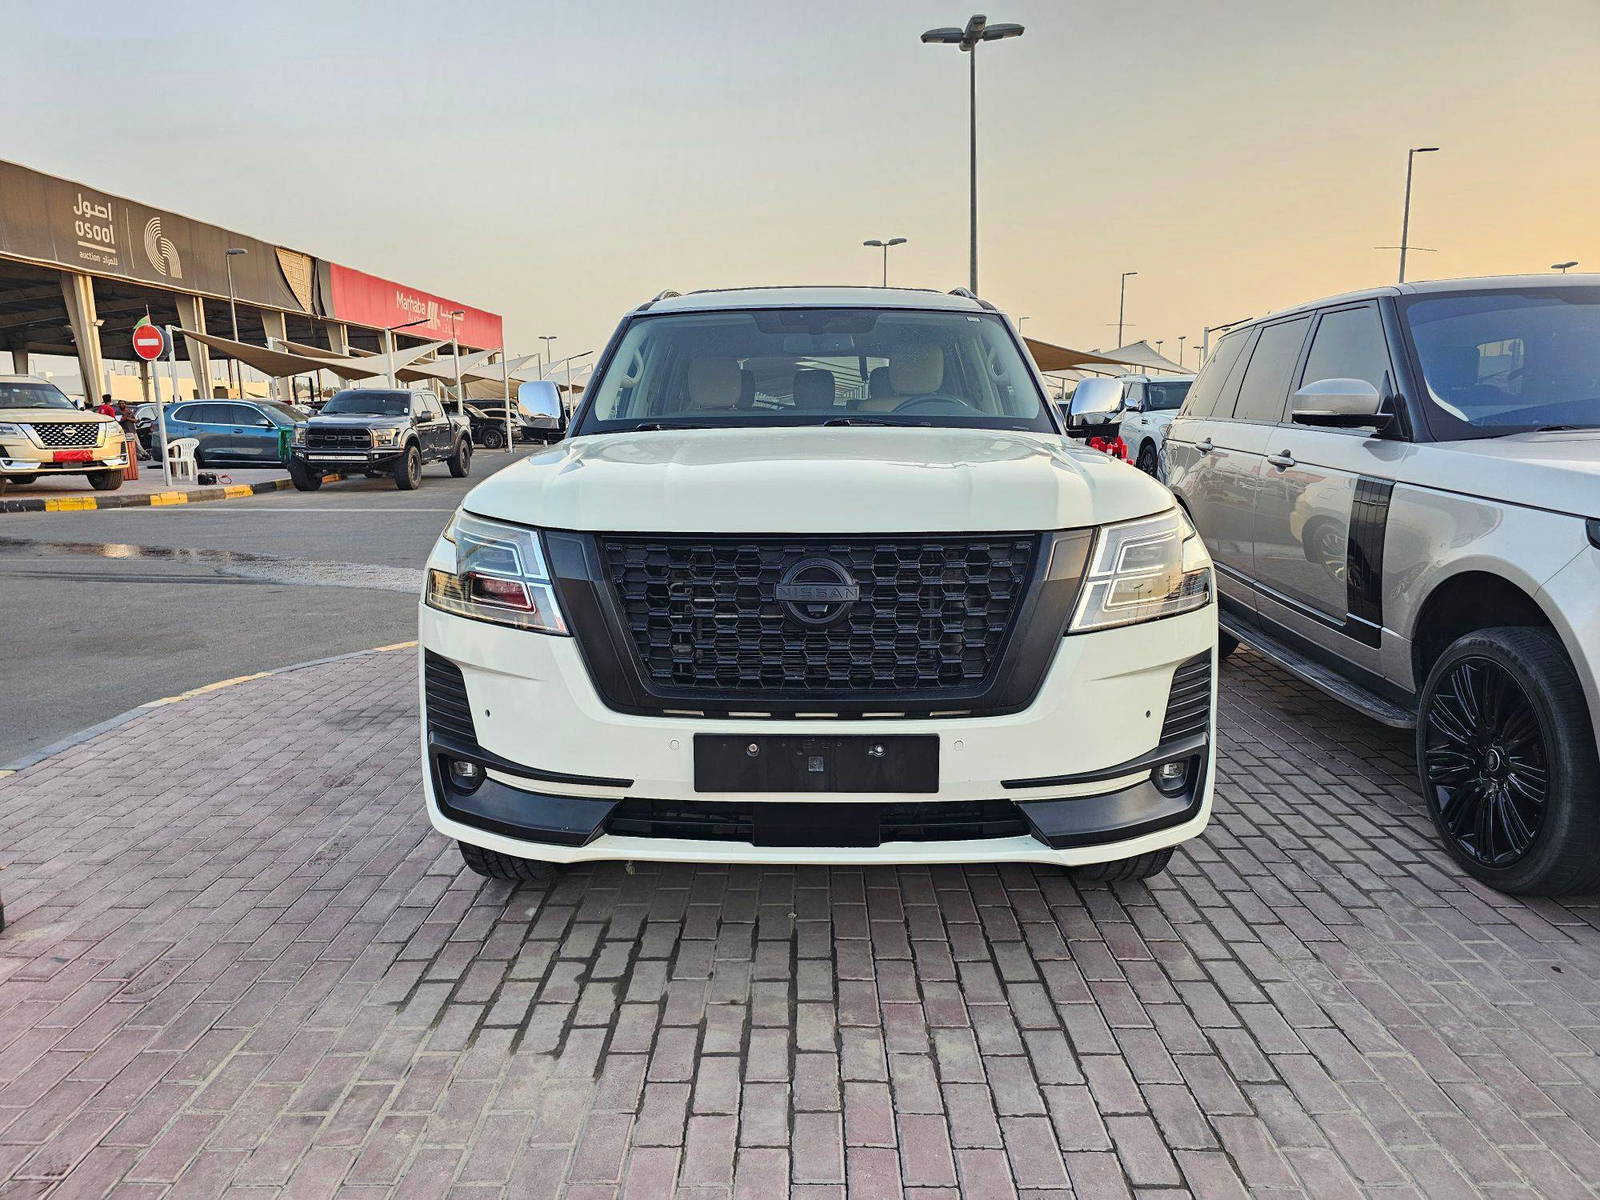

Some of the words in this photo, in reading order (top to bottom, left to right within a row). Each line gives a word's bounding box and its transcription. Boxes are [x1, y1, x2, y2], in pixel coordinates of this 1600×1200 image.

[73, 193, 112, 221] اصول
[75, 220, 115, 245] osool
[79, 251, 101, 262] auction
[396, 290, 426, 314] Marhaba
[308, 434, 371, 442] FORD
[778, 585, 858, 599] NISSAN
